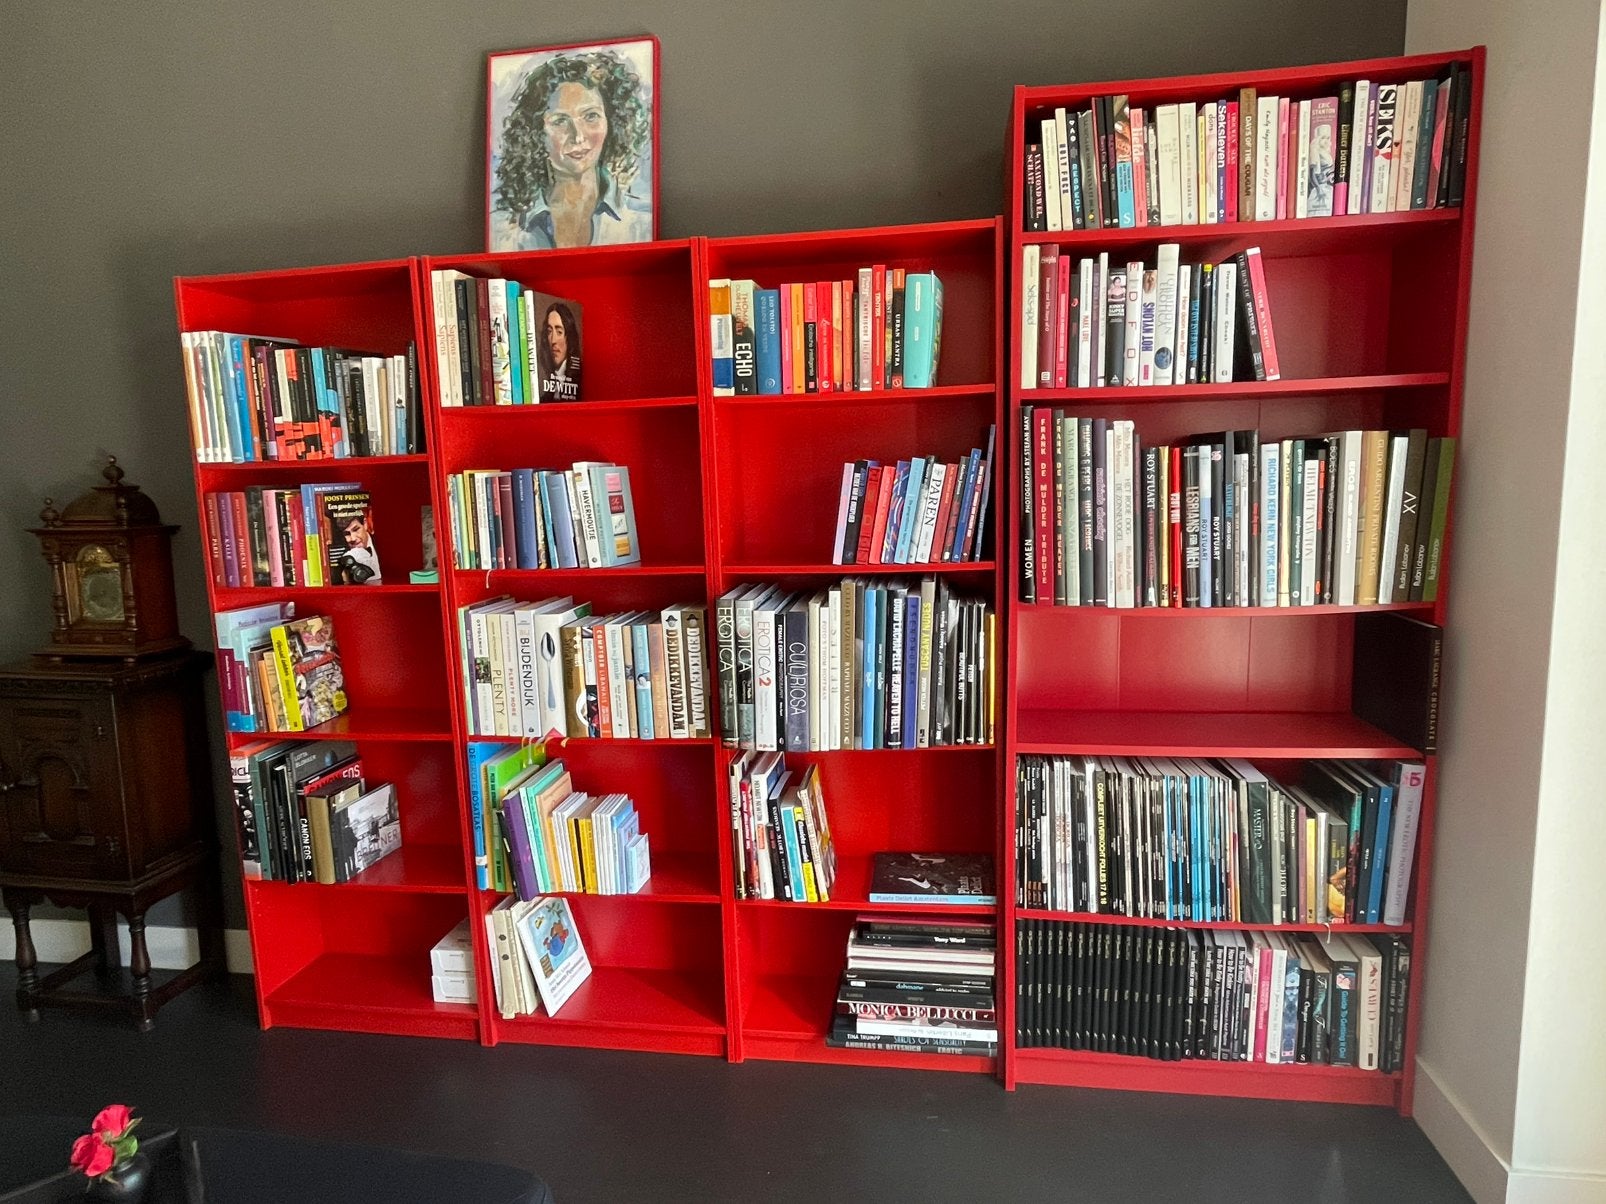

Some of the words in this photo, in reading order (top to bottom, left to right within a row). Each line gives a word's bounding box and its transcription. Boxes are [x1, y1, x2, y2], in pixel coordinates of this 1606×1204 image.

[1133, 128, 1143, 163] liefde
[1218, 106, 1226, 168] Seksleven
[1245, 137, 1251, 146] OF
[1341, 124, 1349, 147] Elmer
[1072, 164, 1081, 212] RESPECT
[1143, 302, 1154, 332] NYLONS
[438, 325, 447, 356] Sapiens
[448, 325, 457, 355] Sapiens
[527, 332, 534, 346] DE
[1142, 335, 1153, 352] HOT
[735, 343, 753, 376] ECHO
[543, 380, 555, 392] DE
[557, 381, 578, 395] WITT
[1024, 457, 1030, 466] BY
[1147, 454, 1155, 473] ROY
[1376, 439, 1384, 465] GUIDO
[1040, 463, 1047, 477] DE
[1267, 458, 1276, 496] RICHARD
[344, 493, 370, 501] PRINSEN
[1116, 483, 1122, 493] DE
[1147, 474, 1155, 509] STUART
[1307, 467, 1316, 510] HELMUT
[1372, 467, 1383, 511] ARGENTINI
[1402, 491, 1417, 514] XV
[582, 490, 595, 540] HAVERMOUTJE
[924, 479, 942, 527] PAREN
[1040, 484, 1048, 528] MULDER
[1186, 486, 1198, 533] LESBIANS
[1267, 498, 1276, 520] KERN
[1267, 523, 1276, 542] NEW
[1305, 512, 1314, 556] NEWTON
[1369, 514, 1379, 545] PRIVATE
[1186, 547, 1199, 568] MEN
[1267, 545, 1276, 566] YORK
[1367, 547, 1377, 576] ROOMS
[1266, 569, 1276, 593] GIRLS
[894, 599, 902, 620] DAVID
[922, 603, 930, 631] NUDES
[718, 608, 733, 672] EROTICA
[738, 608, 752, 672] EROTICA
[758, 621, 771, 676] EROTICA
[892, 622, 902, 671] LACHAPELLE
[920, 633, 930, 671] TUSCANY
[520, 638, 534, 706] BIJDENDIJK
[666, 629, 685, 730] DEDIKKEVANDAM
[687, 628, 705, 730] DEDIKKEVANDAM
[759, 677, 771, 687] 2
[788, 642, 807, 715] CU(L)RIOSA
[493, 670, 504, 715] PLENTY
[892, 674, 901, 702] HEAVEN
[891, 702, 900, 715] TO
[1428, 692, 1437, 740] CHOCOLATE
[891, 717, 900, 734] HELL
[468, 748, 476, 758] DE
[469, 759, 478, 790] GROTE
[472, 790, 481, 830] BOSATLAS
[1253, 809, 1262, 838] MASTER
[300, 818, 310, 847] CANON
[302, 847, 312, 860] EOS
[1100, 883, 1106, 891] 17
[896, 983, 924, 991] dahmane
[1341, 991, 1349, 1010] Guide
[849, 1003, 901, 1016] MONICA
[907, 1006, 976, 1021] BELLUCCI
[845, 1041, 876, 1049] ANDREAS
[937, 1046, 962, 1055] EROTIC
